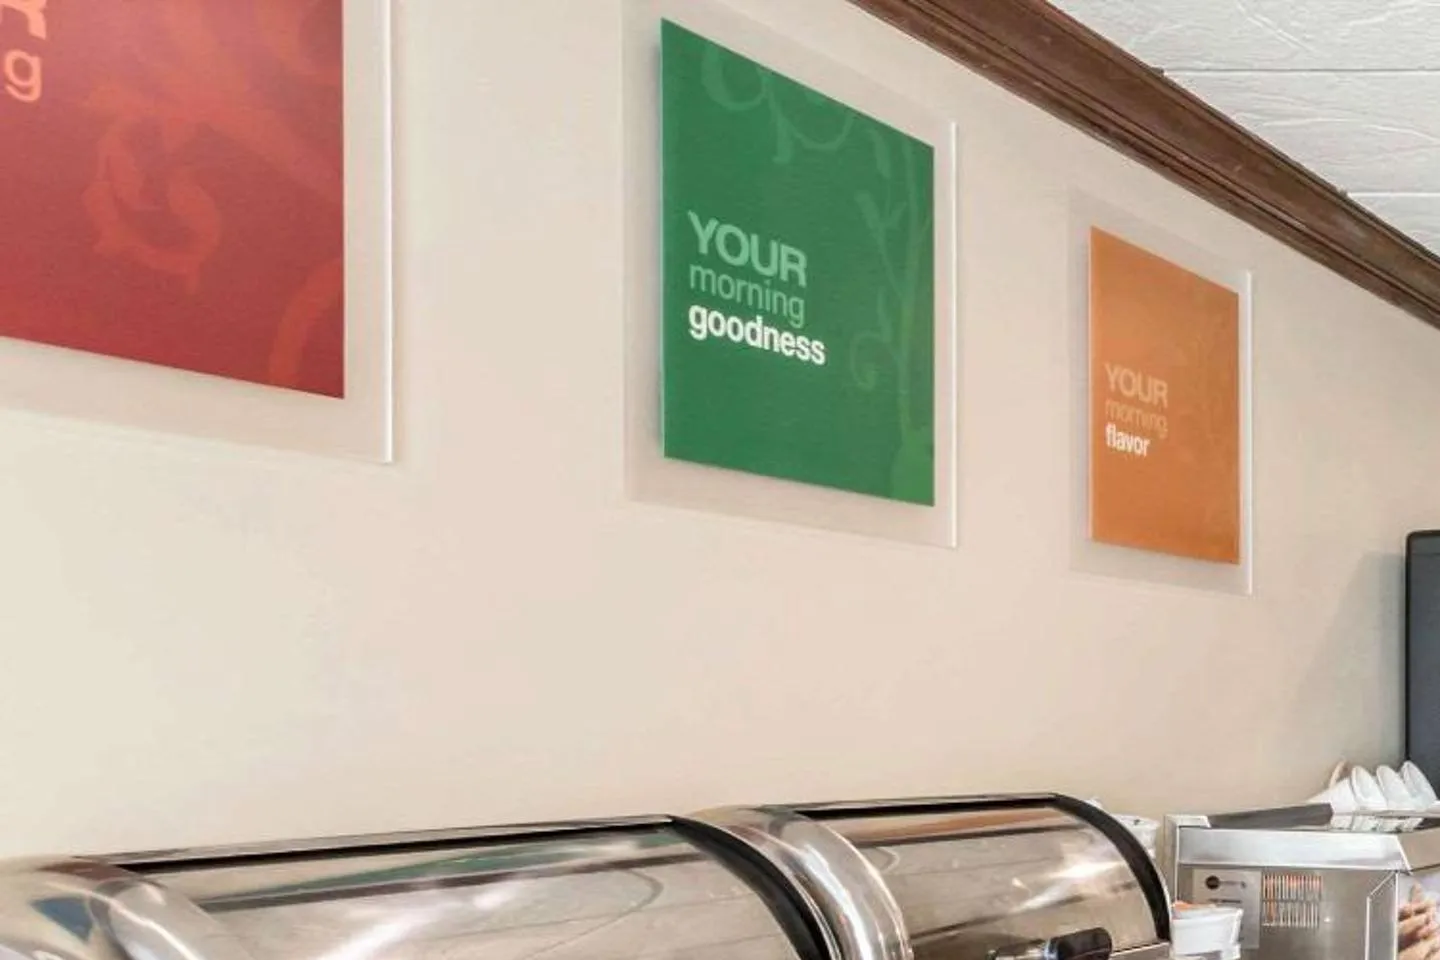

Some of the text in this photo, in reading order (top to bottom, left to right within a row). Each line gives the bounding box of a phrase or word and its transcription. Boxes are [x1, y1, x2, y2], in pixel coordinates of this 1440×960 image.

[687, 210, 807, 288] YOUR
[689, 264, 804, 328] morning
[688, 304, 826, 365] goodness
[1104, 362, 1168, 408] YOUR
[1105, 399, 1168, 439] morning
[1105, 421, 1151, 457] flavor
